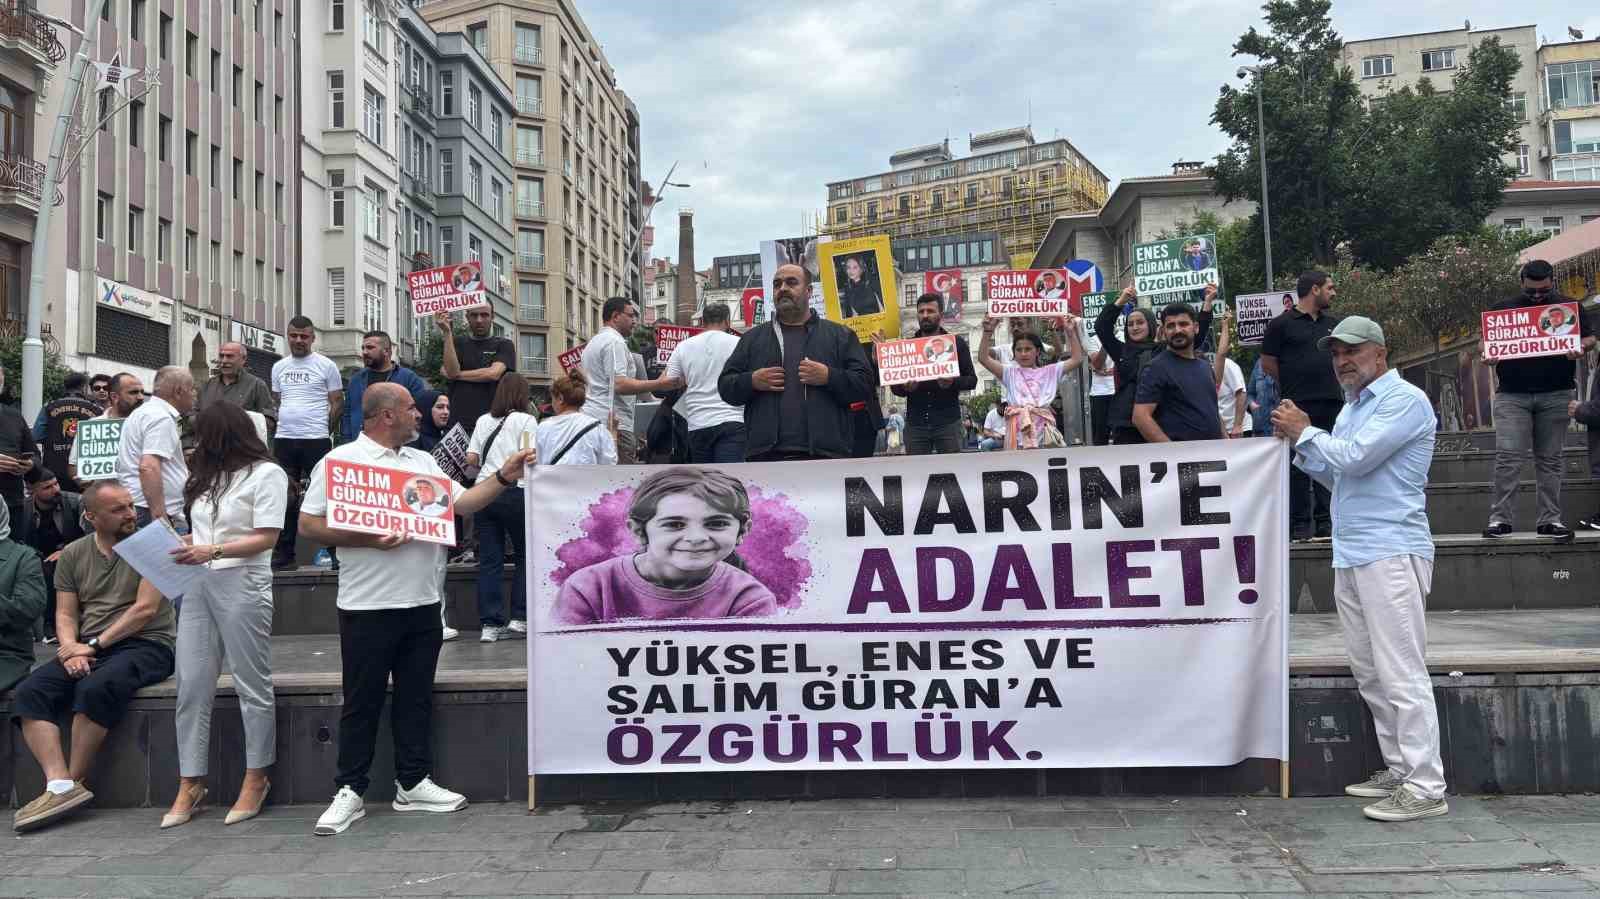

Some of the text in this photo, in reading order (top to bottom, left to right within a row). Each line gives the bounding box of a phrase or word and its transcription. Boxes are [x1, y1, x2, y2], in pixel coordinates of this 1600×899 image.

[1136, 244, 1169, 261] ENES
[1137, 258, 1180, 275] GÜRAN'A
[411, 271, 445, 288] SALİM
[991, 271, 1028, 286] SALİM
[1139, 271, 1215, 292] ÖZGÜRLÜK!
[413, 283, 453, 299] GÜRAN'A
[991, 286, 1034, 298] GÜRAN'A
[416, 294, 482, 314] ÖZGÜRLÜK!
[991, 300, 1063, 313] ÖZGÜRLÜK!
[1082, 294, 1106, 307] ENES
[1239, 297, 1268, 308] YÜKSEL
[1239, 308, 1273, 319] GÜRAN'A
[1486, 311, 1530, 328] SALİM
[660, 327, 690, 341] SALİM
[1487, 325, 1539, 341] GÜRAN'A
[880, 341, 916, 357] SALİM
[1489, 335, 1575, 356] ÖZGÜRLÜK!
[881, 354, 925, 368] GÜRAN'A
[883, 362, 954, 382] ÖZGÜRLÜK!
[82, 422, 120, 440] ENES
[82, 440, 120, 456] GÜRAN
[332, 466, 391, 490] SALİM
[332, 485, 402, 510] GÜRAN'A
[844, 457, 1231, 537] NARİN'E
[333, 504, 447, 539] ÖZGÜRLÜK!
[847, 535, 1258, 615] ADALET!
[606, 638, 1095, 677] YÜKSEL, ENES VE
[606, 673, 1063, 715] SALİM GÜRAN'A
[606, 713, 1043, 765] ÖZGÜRLÜK.
